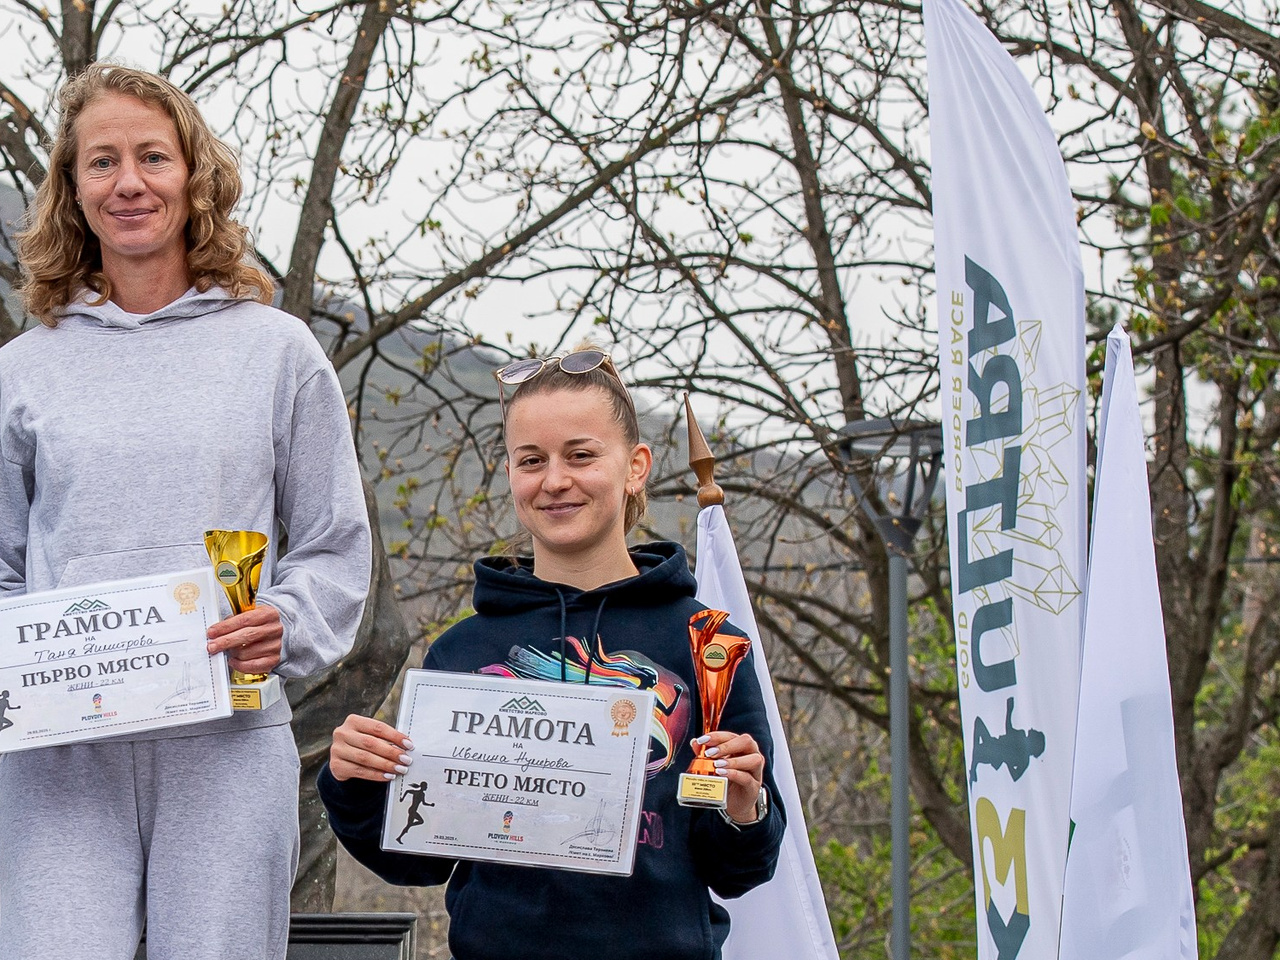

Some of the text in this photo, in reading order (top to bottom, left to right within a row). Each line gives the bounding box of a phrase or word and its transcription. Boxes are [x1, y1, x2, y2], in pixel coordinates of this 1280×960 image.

[16, 606, 166, 644] ГРАМОТА
[34, 648, 76, 663] Таня
[21, 652, 170, 687] ПЪРВО МЯСТО
[67, 680, 94, 692] ЖЕНИ
[100, 679, 111, 687] 22
[81, 713, 103, 722] PLOVDIV
[448, 710, 596, 746] ГРАМОТА
[452, 746, 509, 764] Ивелина
[444, 768, 586, 798] ТРЕТО МЯСТО
[482, 792, 509, 803] ЖЕНИ
[514, 796, 525, 804] 22
[487, 833, 509, 841] PLOVDIV
